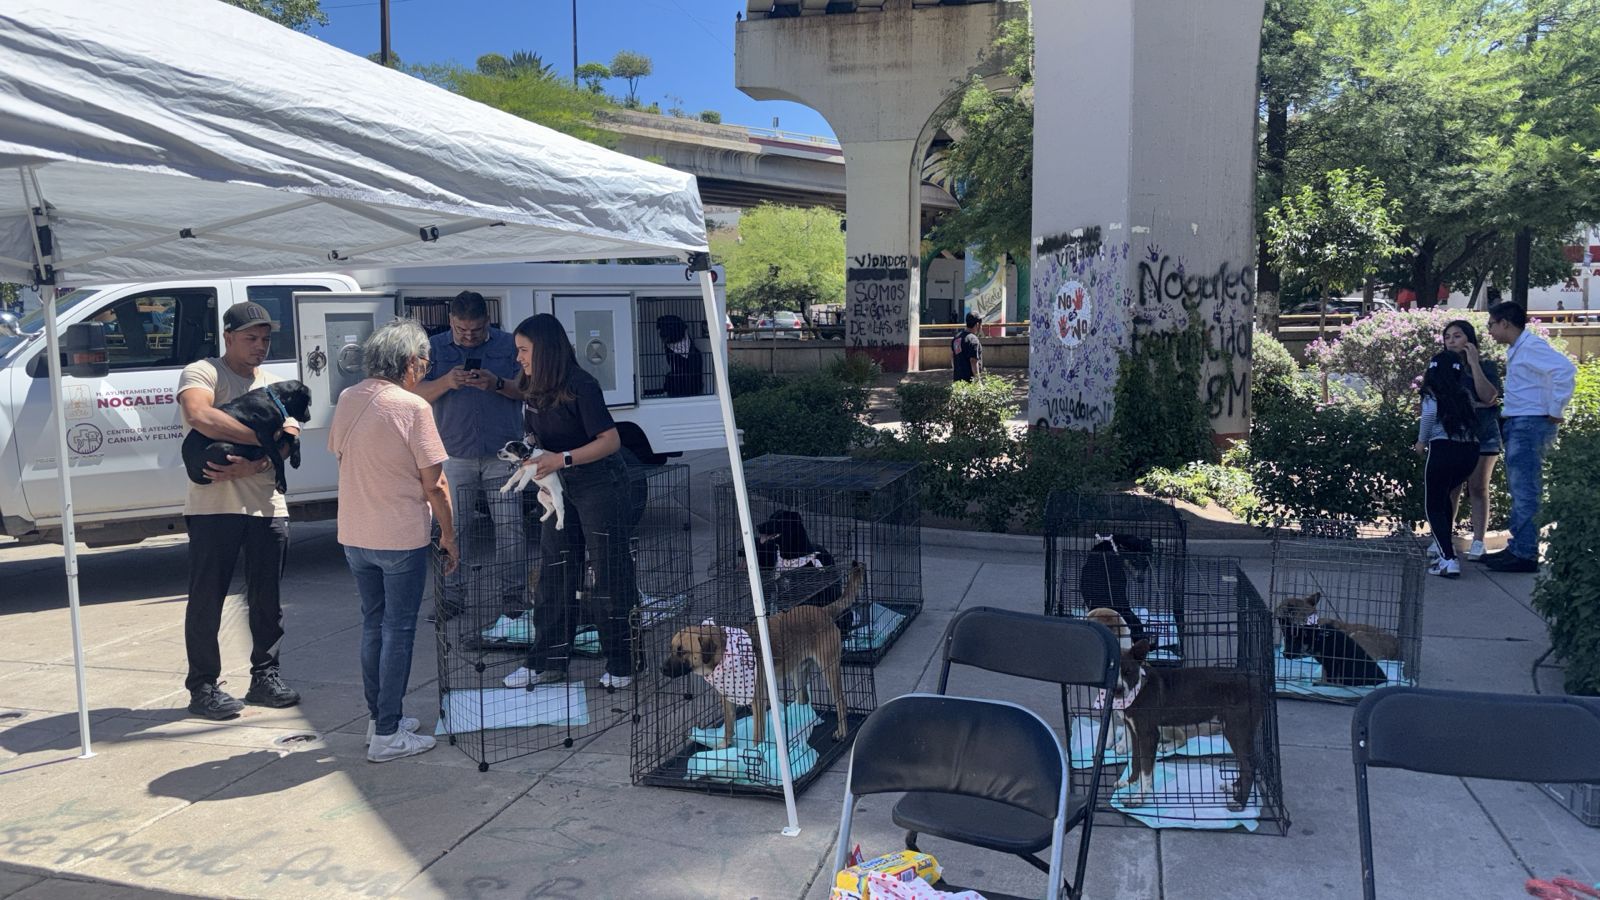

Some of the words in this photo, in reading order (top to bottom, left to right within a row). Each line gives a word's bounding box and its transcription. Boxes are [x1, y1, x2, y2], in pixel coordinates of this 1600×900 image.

[854, 282, 905, 303] SOMOS
[1138, 256, 1252, 313] Nogales
[1058, 293, 1072, 310] NO
[850, 320, 866, 336] DE
[1072, 319, 1088, 340] NO
[105, 387, 162, 397] AYUNTAMIENTO
[97, 394, 174, 408] NOGALES
[106, 427, 136, 436] CENTRO
[107, 435, 144, 445] CANINA
[144, 433, 151, 441] Y
[152, 432, 184, 441] FELINA
